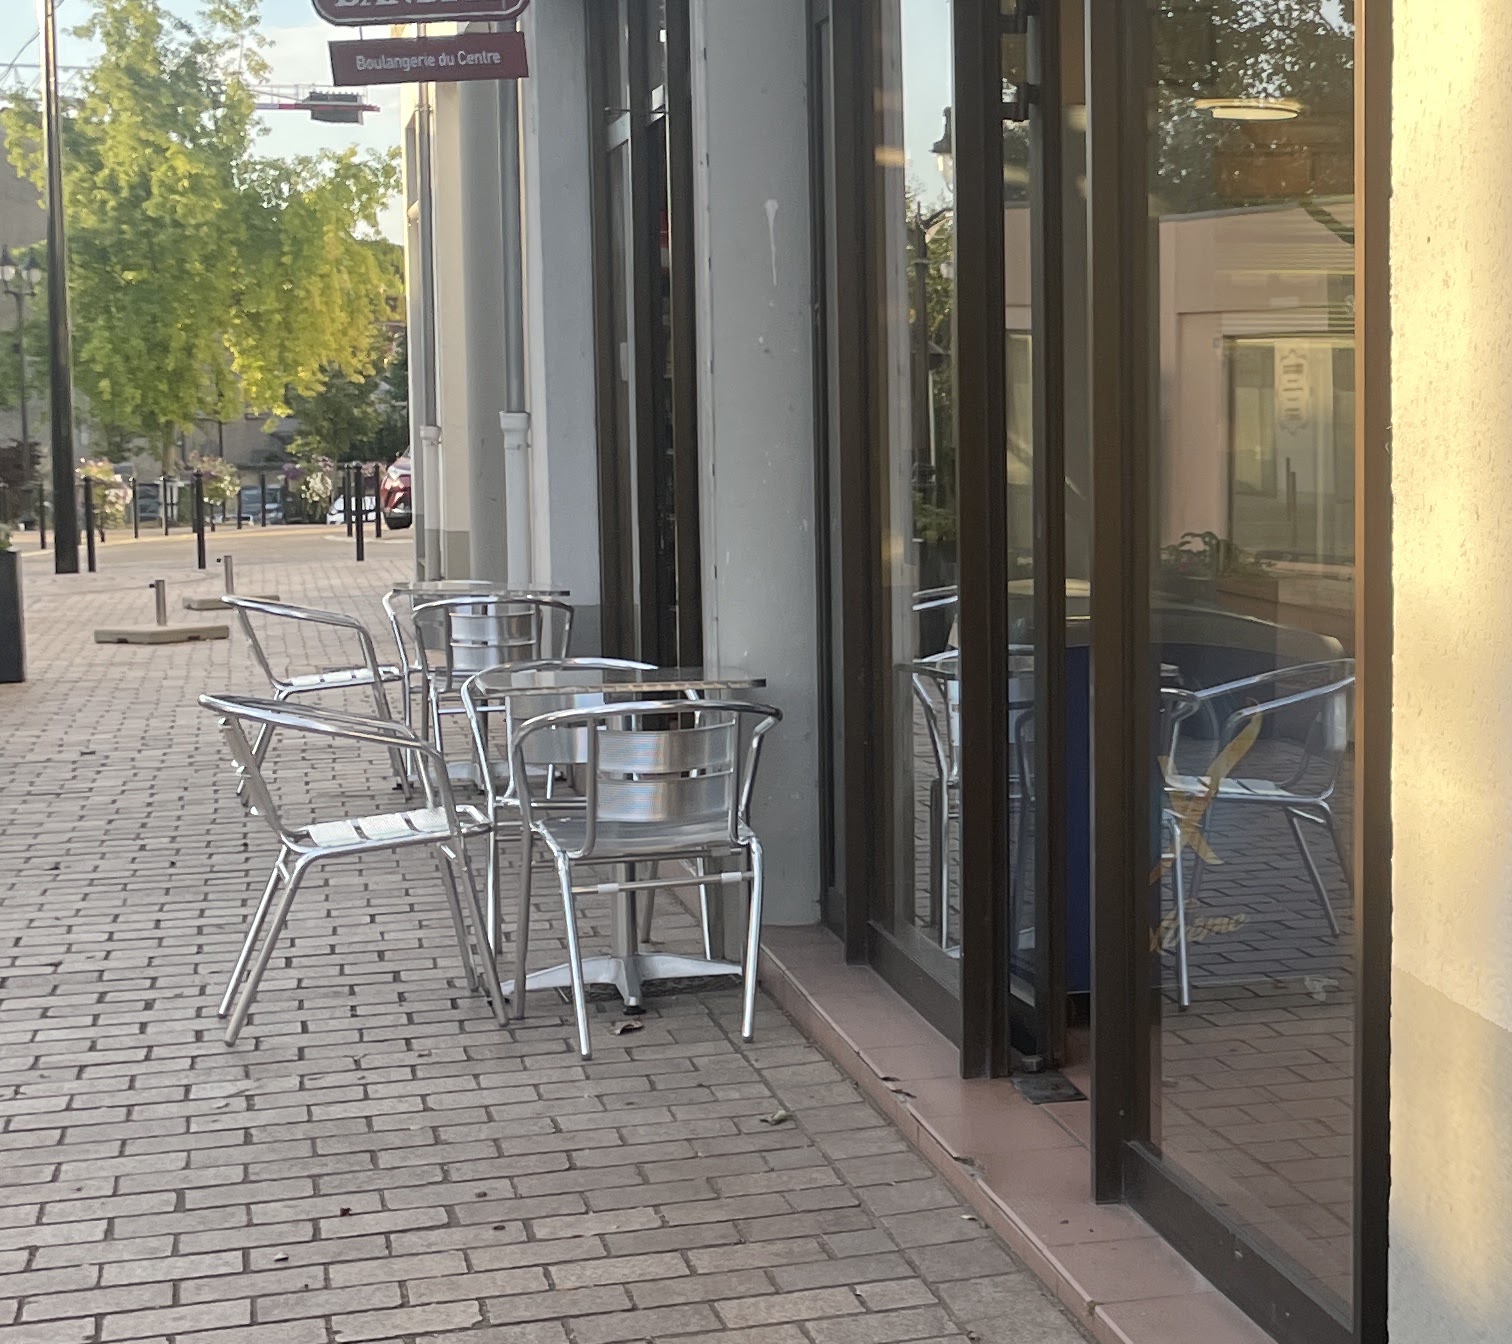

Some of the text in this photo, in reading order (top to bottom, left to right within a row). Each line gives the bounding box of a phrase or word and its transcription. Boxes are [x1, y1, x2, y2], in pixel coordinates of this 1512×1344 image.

[356, 49, 502, 72] Boulangerie du Centre
